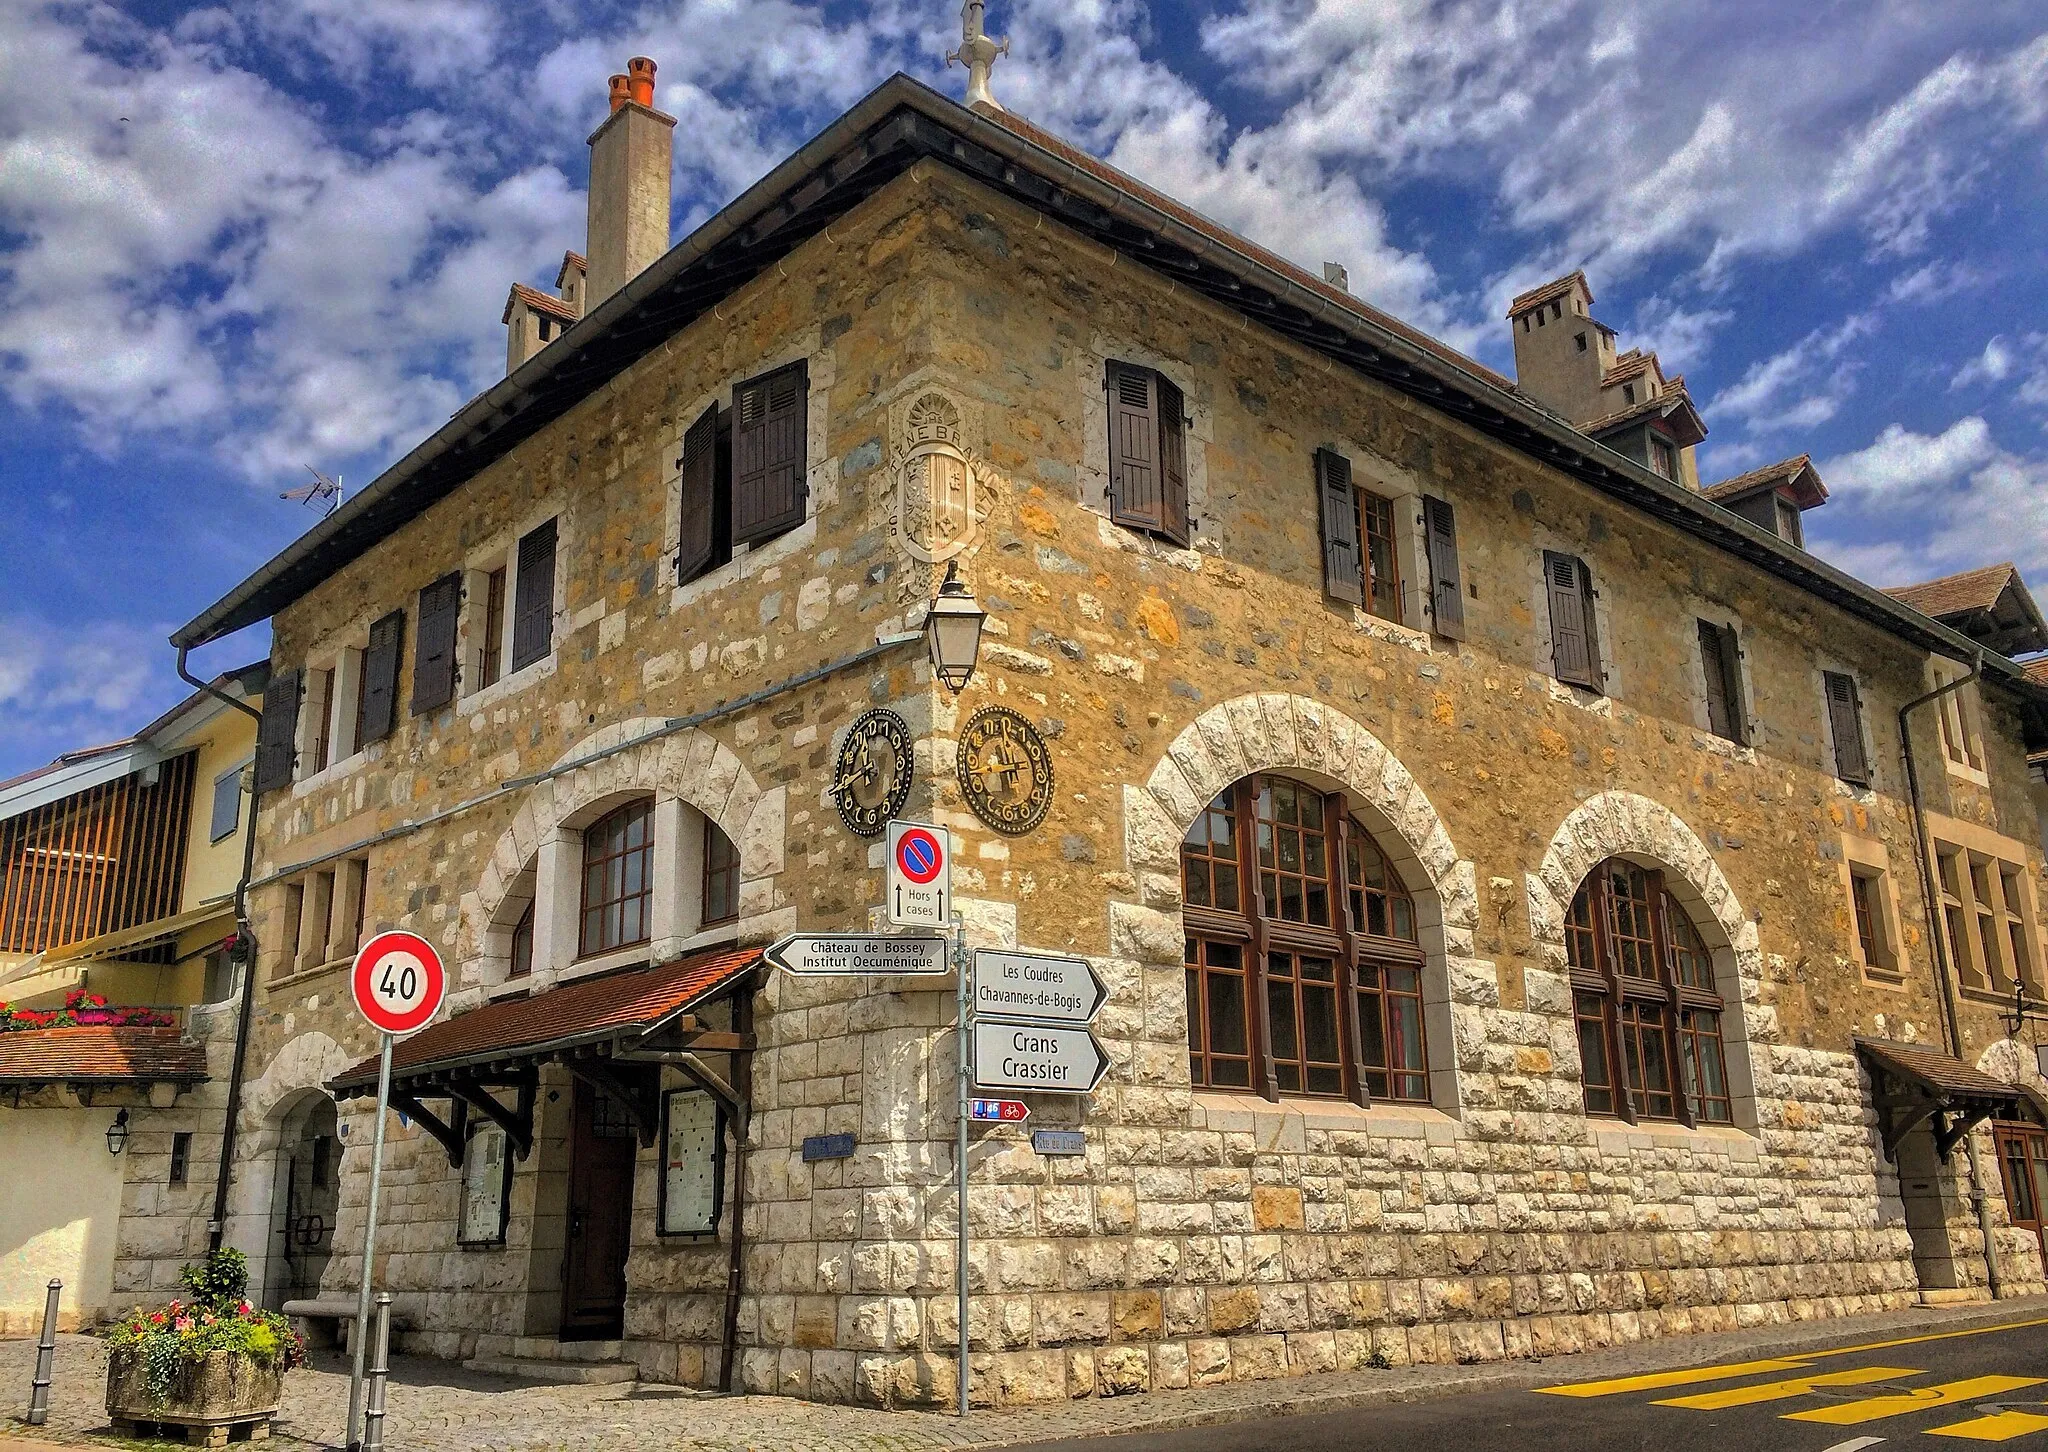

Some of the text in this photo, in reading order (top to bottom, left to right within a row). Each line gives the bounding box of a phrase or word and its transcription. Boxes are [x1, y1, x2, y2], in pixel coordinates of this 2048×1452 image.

[908, 888, 931, 902] Hors
[906, 905, 934, 917] cases
[810, 941, 926, 957] Château de Bossey
[803, 955, 933, 970] Institut Oecuménique
[379, 964, 417, 1000] 40
[1003, 963, 1064, 984] Les Coudres
[979, 984, 1082, 1013] Chavannes-de-Bogis
[1013, 1031, 1058, 1054] Crans
[1002, 1057, 1069, 1081] Crassier
